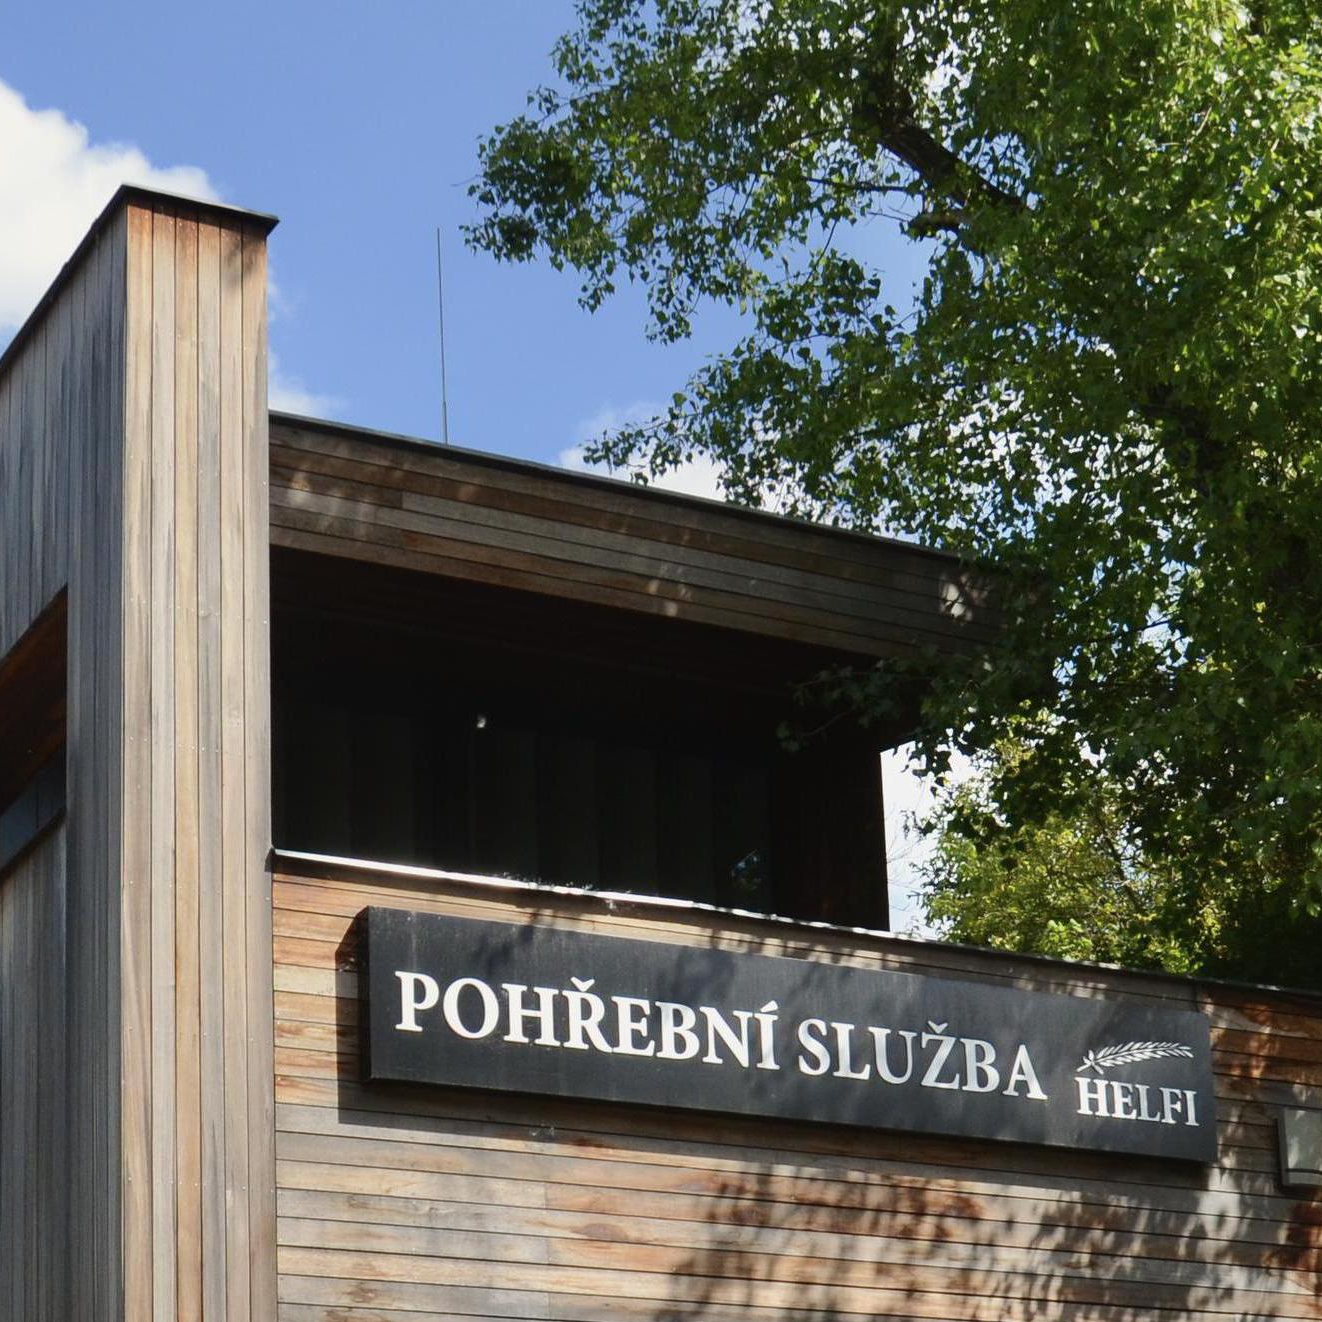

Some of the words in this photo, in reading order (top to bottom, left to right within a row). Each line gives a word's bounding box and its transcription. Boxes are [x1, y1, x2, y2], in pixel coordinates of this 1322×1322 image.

[394, 971, 780, 1071] POHŘEBNÍ
[797, 1018, 1049, 1101] SLUŽBA
[1074, 1076, 1200, 1127] HELFI
